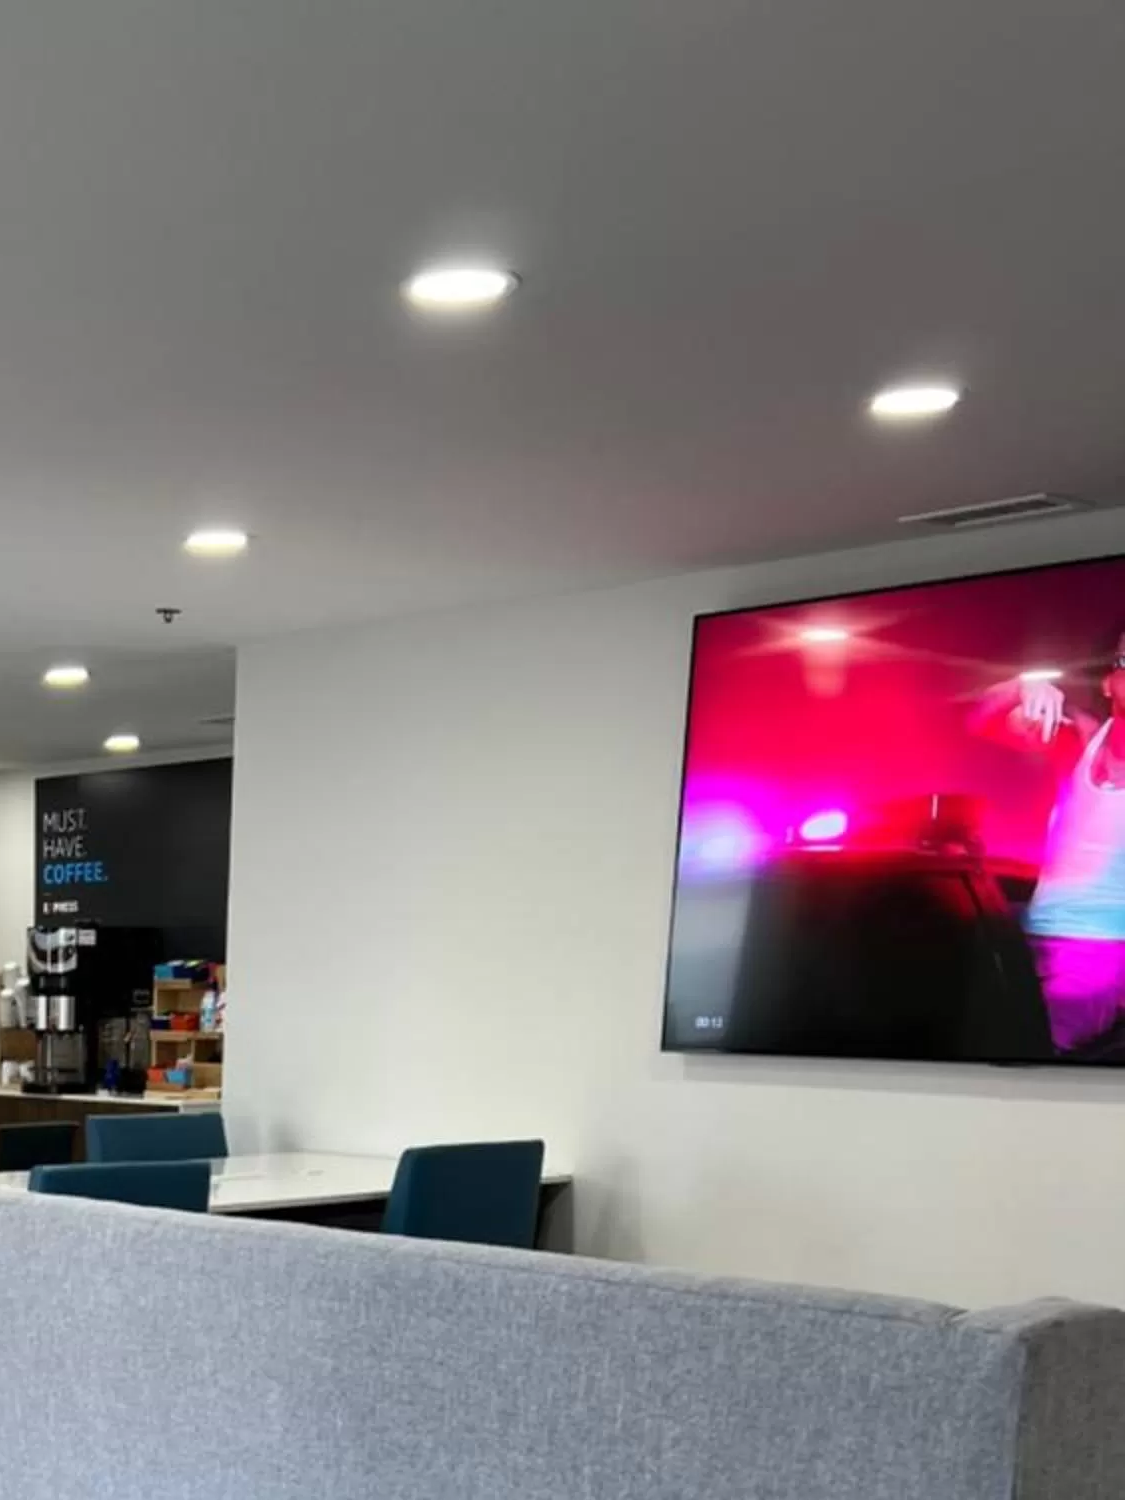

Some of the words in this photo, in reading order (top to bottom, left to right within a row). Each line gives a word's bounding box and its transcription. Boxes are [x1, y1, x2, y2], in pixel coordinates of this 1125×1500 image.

[43, 807, 88, 832] MUST.
[43, 835, 87, 858] HAVE.
[43, 861, 108, 884] COFFEE.
